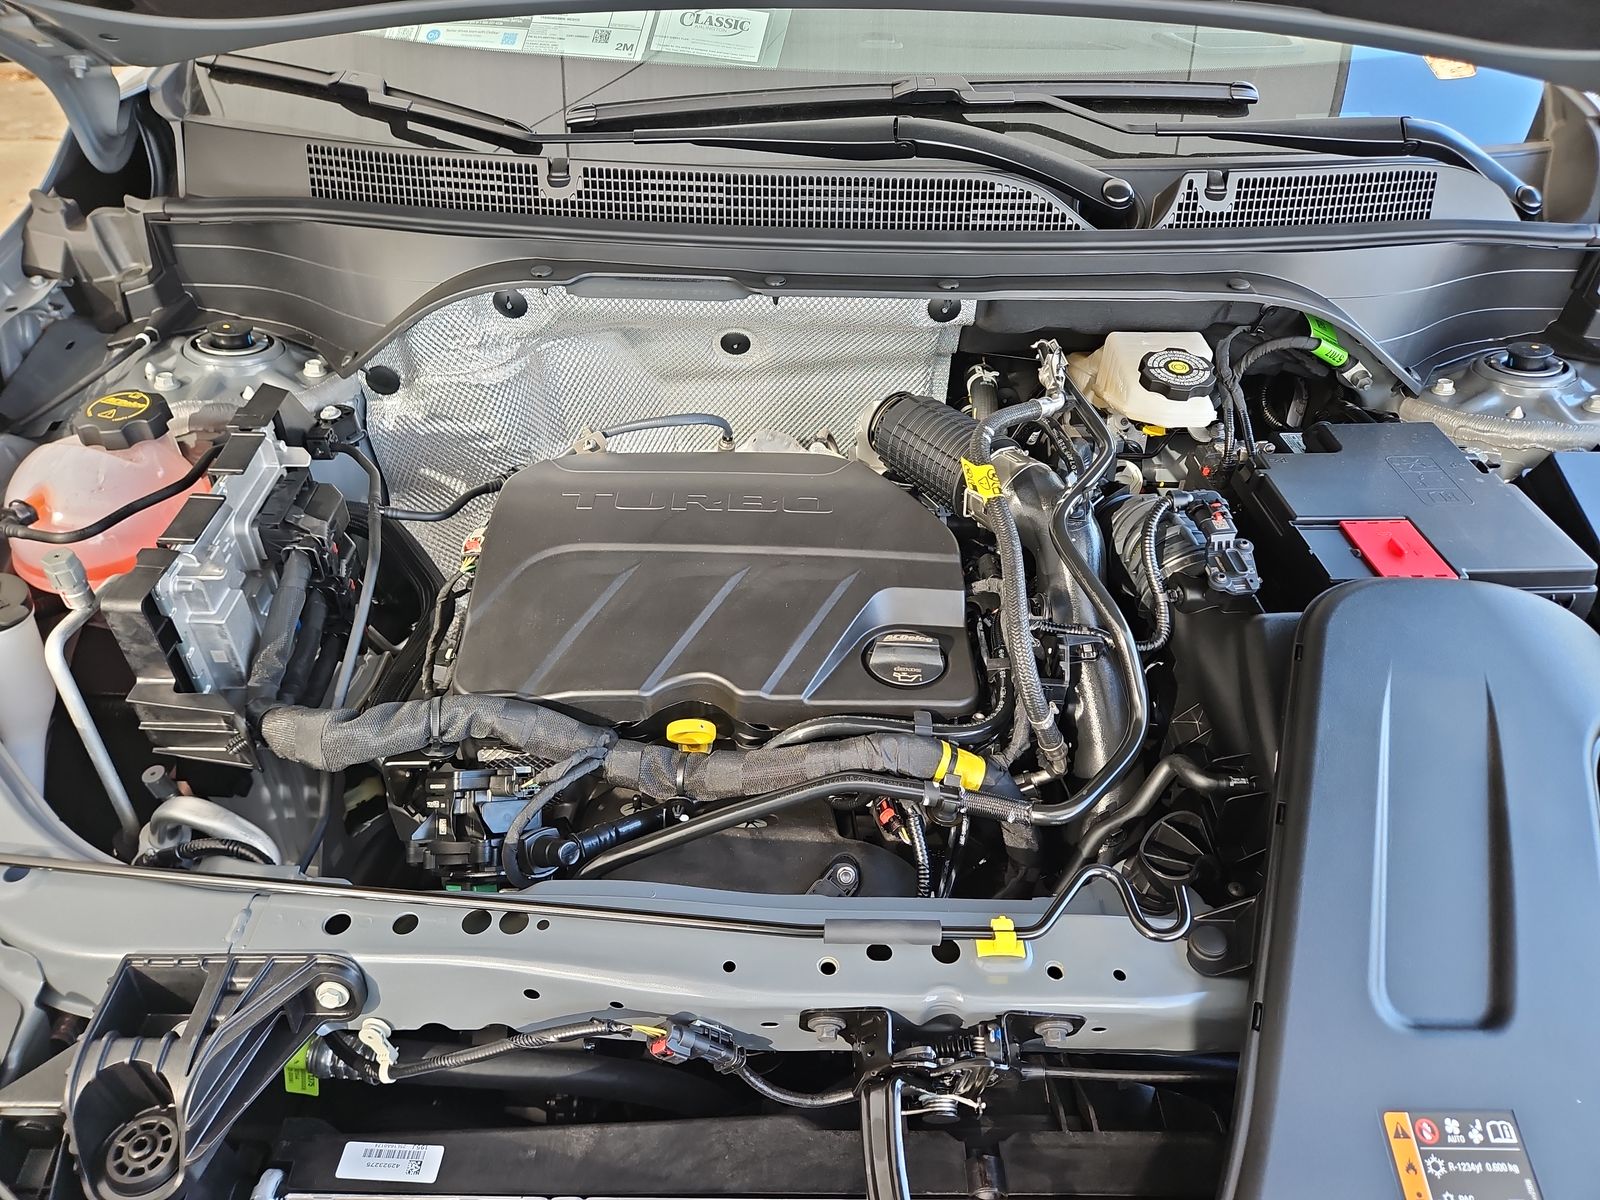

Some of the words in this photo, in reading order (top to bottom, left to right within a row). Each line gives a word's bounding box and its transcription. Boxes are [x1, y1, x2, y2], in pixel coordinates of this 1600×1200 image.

[680, 11, 751, 32] CLASSIC
[615, 42, 635, 52] 2M
[561, 489, 834, 514] TURBO
[883, 634, 934, 643] ACDelco
[1448, 1135, 1465, 1143] AUTO
